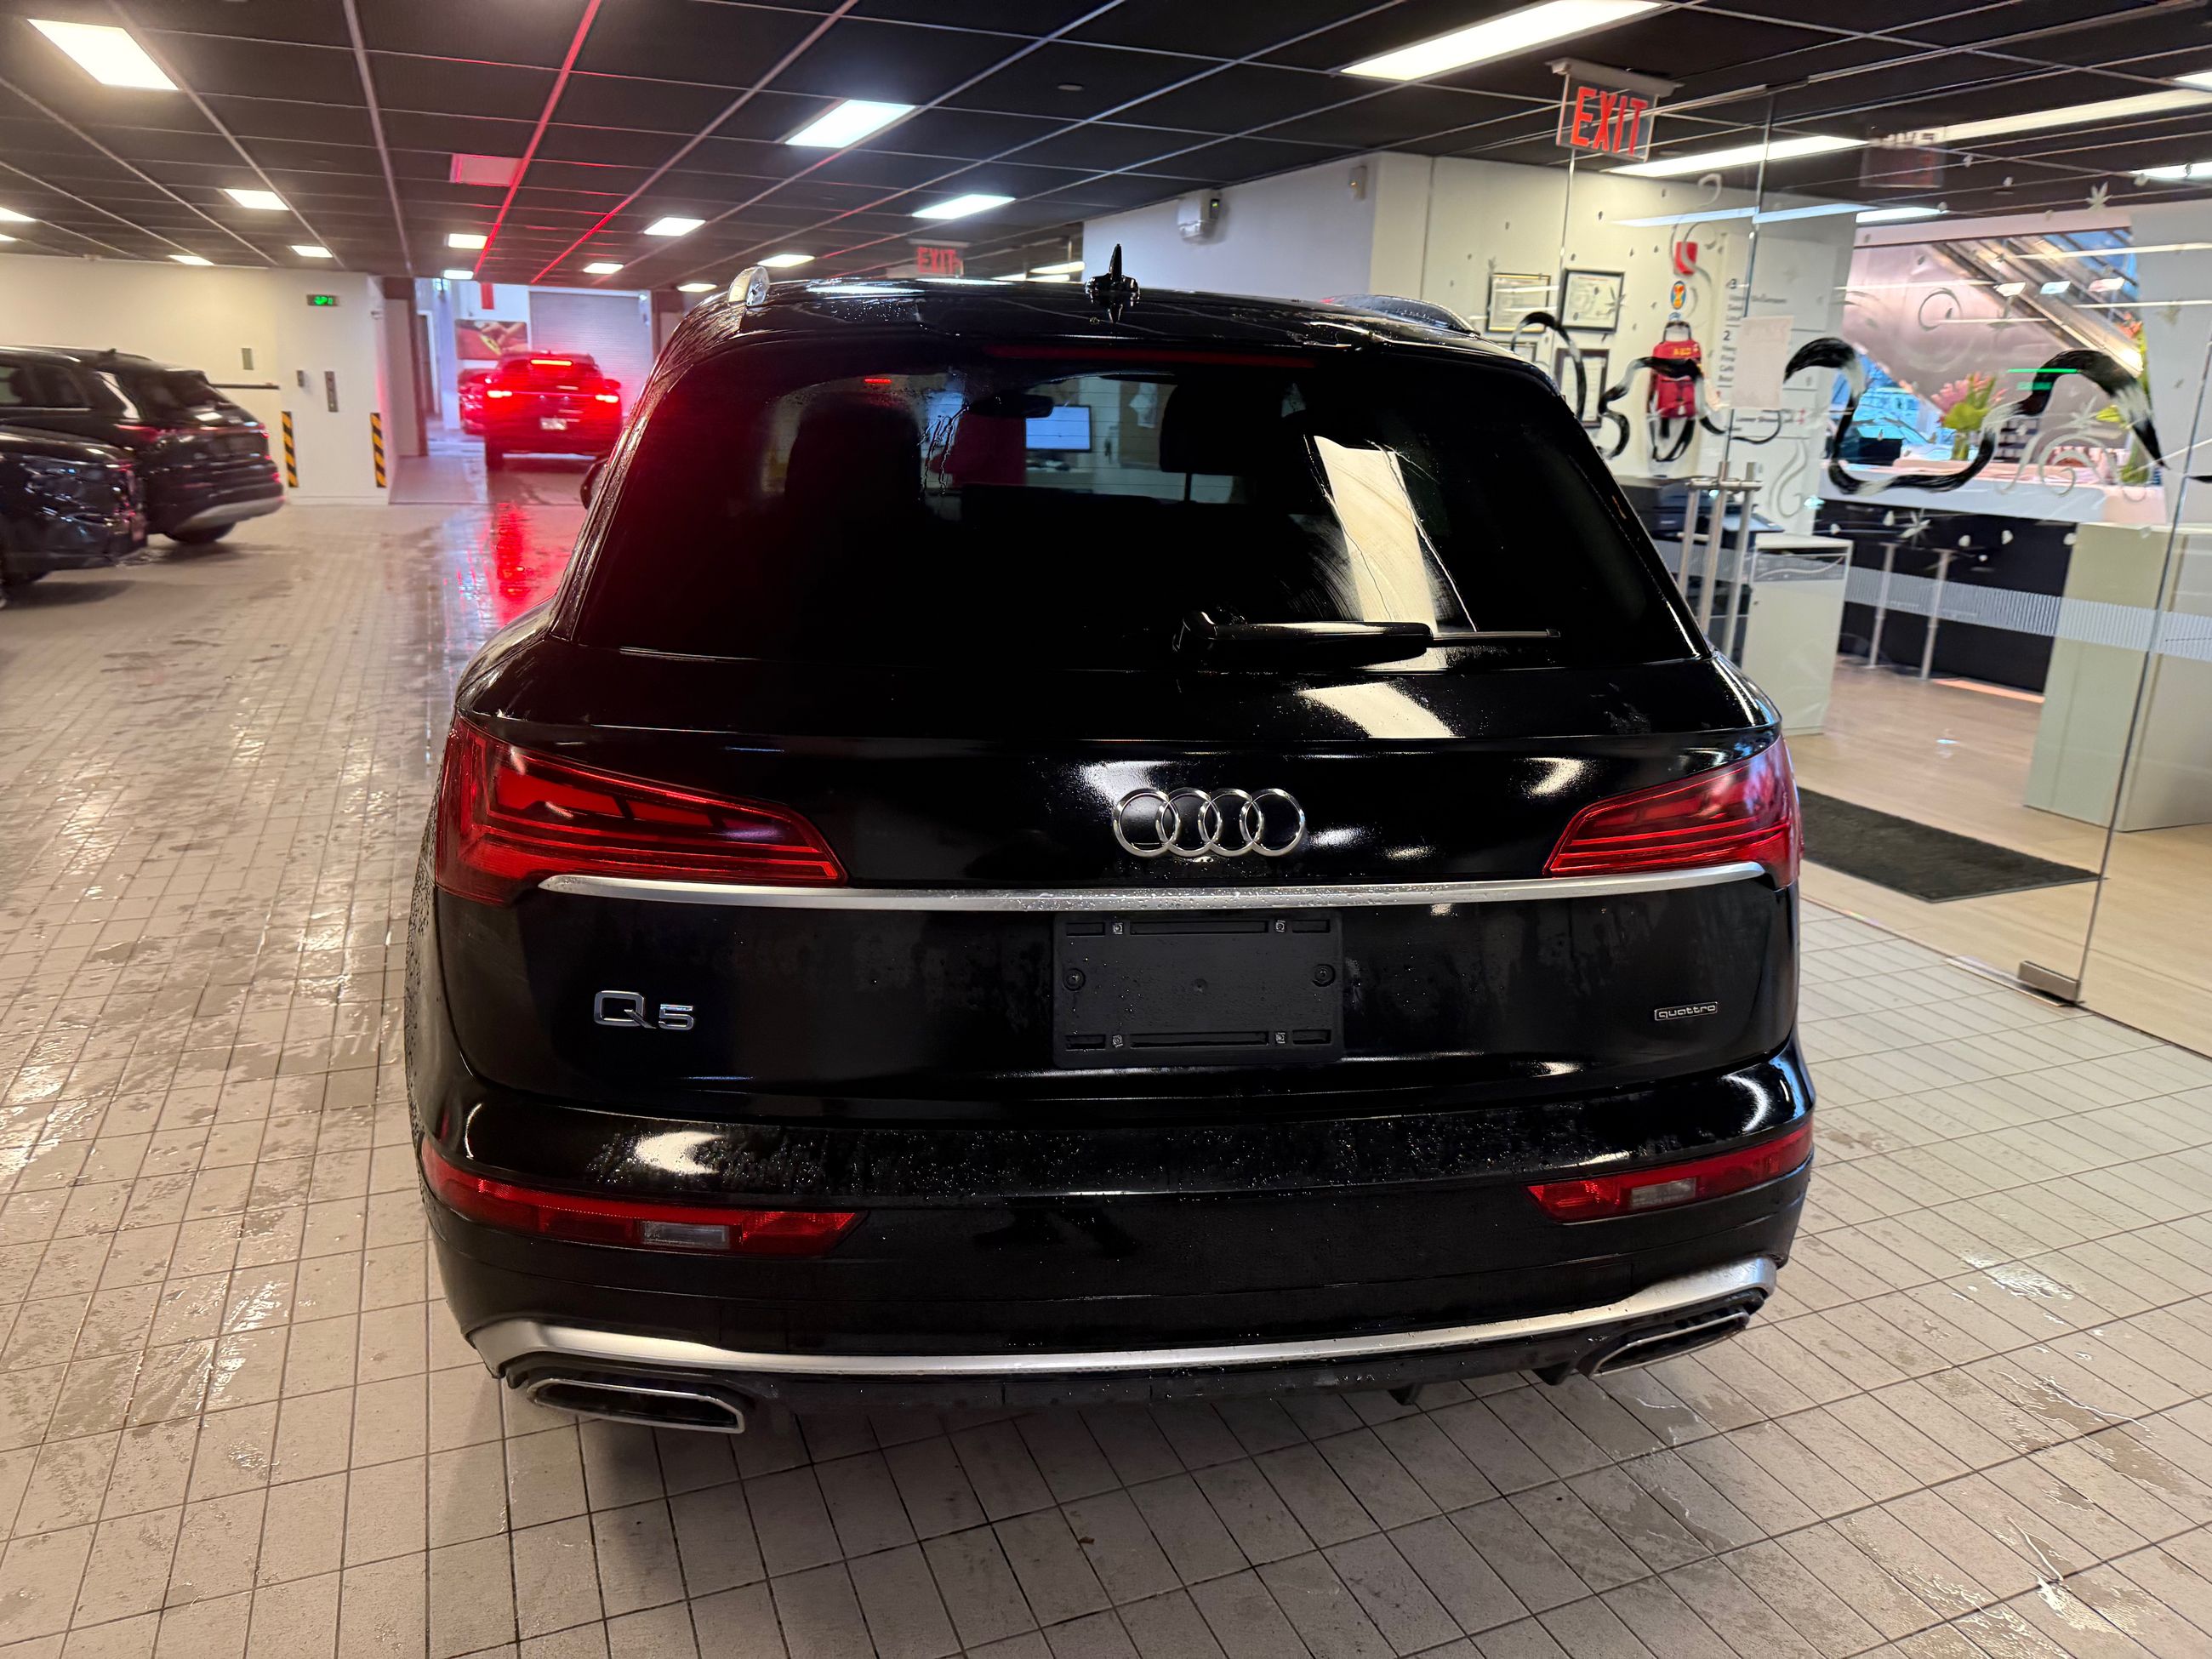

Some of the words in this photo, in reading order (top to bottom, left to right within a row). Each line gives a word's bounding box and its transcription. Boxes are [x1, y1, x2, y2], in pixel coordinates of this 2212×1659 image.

[1571, 86, 1648, 157] EXIT
[917, 247, 956, 274] EXIT
[1723, 330, 1730, 341] 2
[594, 990, 694, 1030] Q5
[1658, 1005, 1716, 1018] quattro
